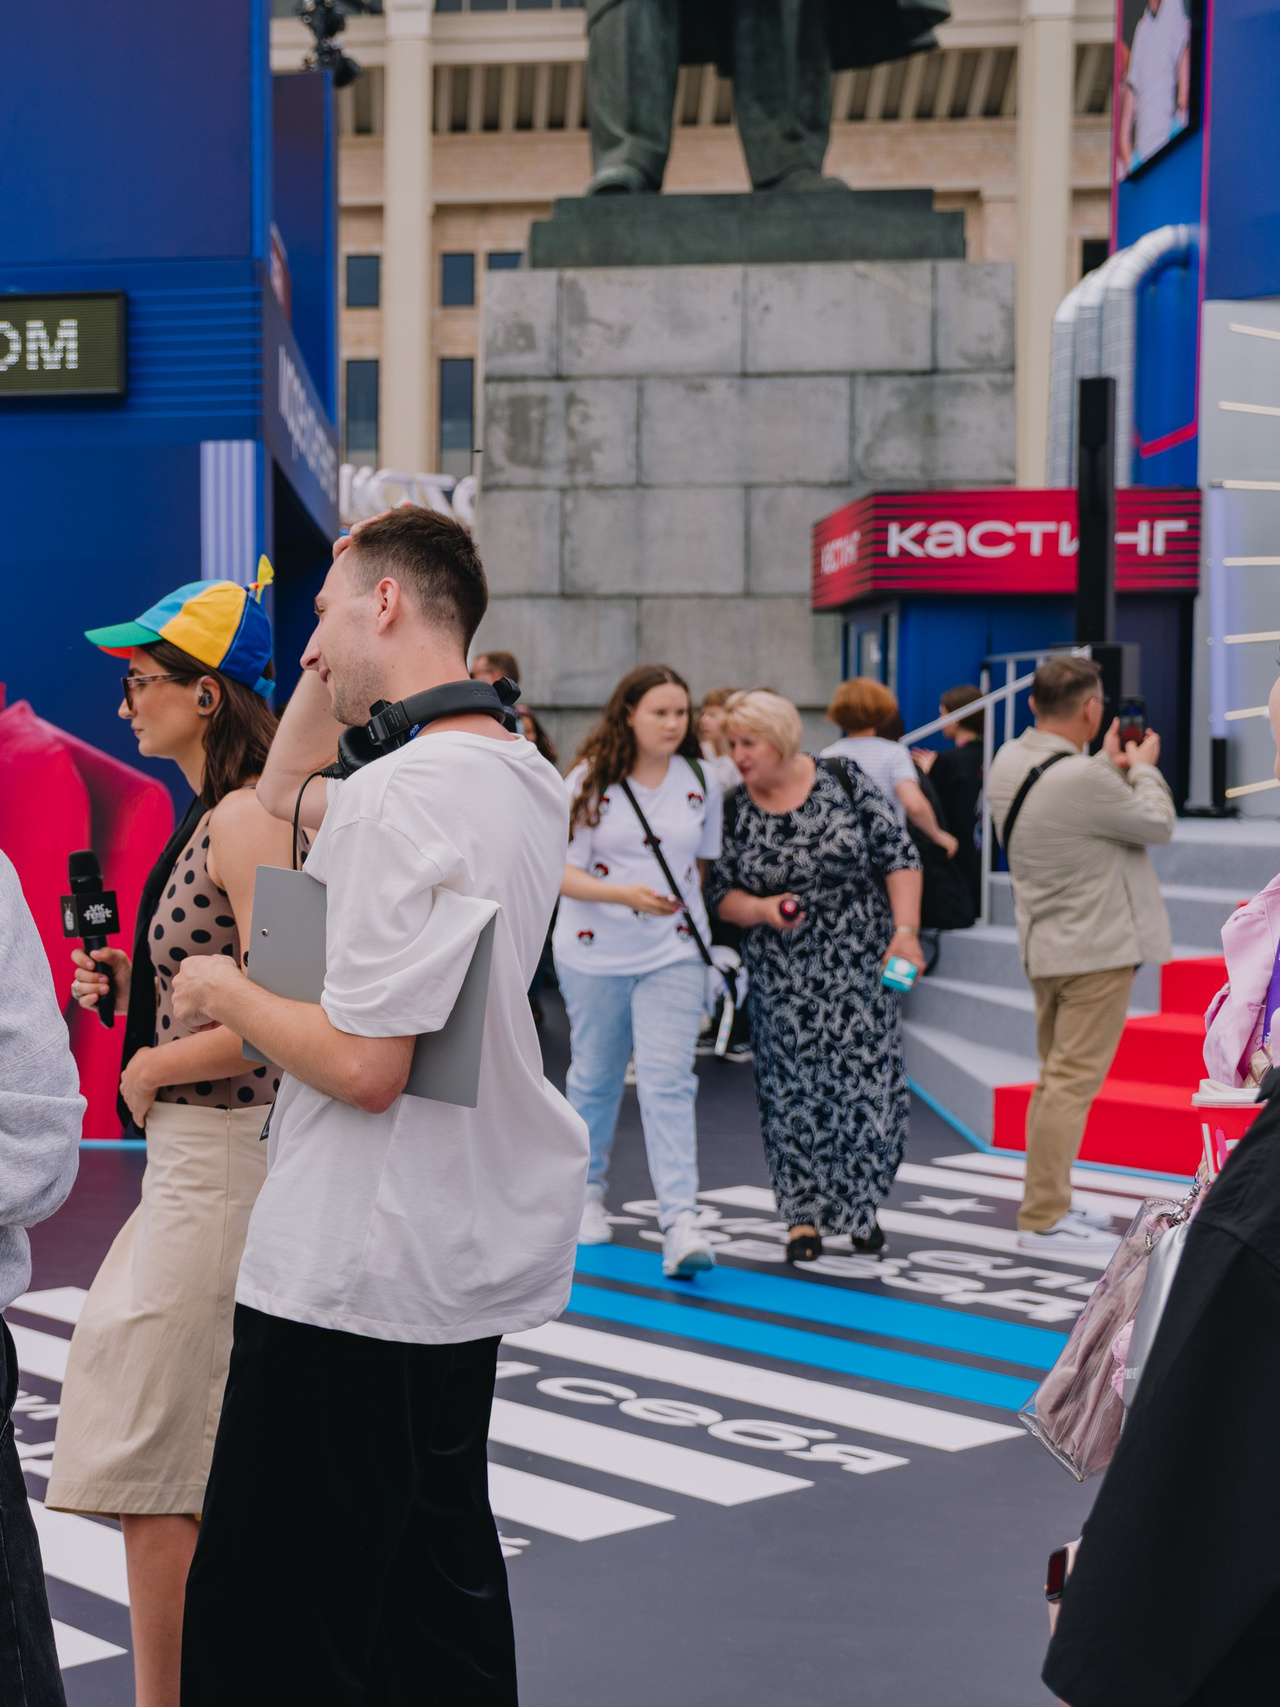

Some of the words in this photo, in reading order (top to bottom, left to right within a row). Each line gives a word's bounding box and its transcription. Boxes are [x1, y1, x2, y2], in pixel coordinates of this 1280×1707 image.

[83, 908, 112, 921] fest
[89, 904, 105, 912] VK
[536, 1376, 910, 1475] себя
